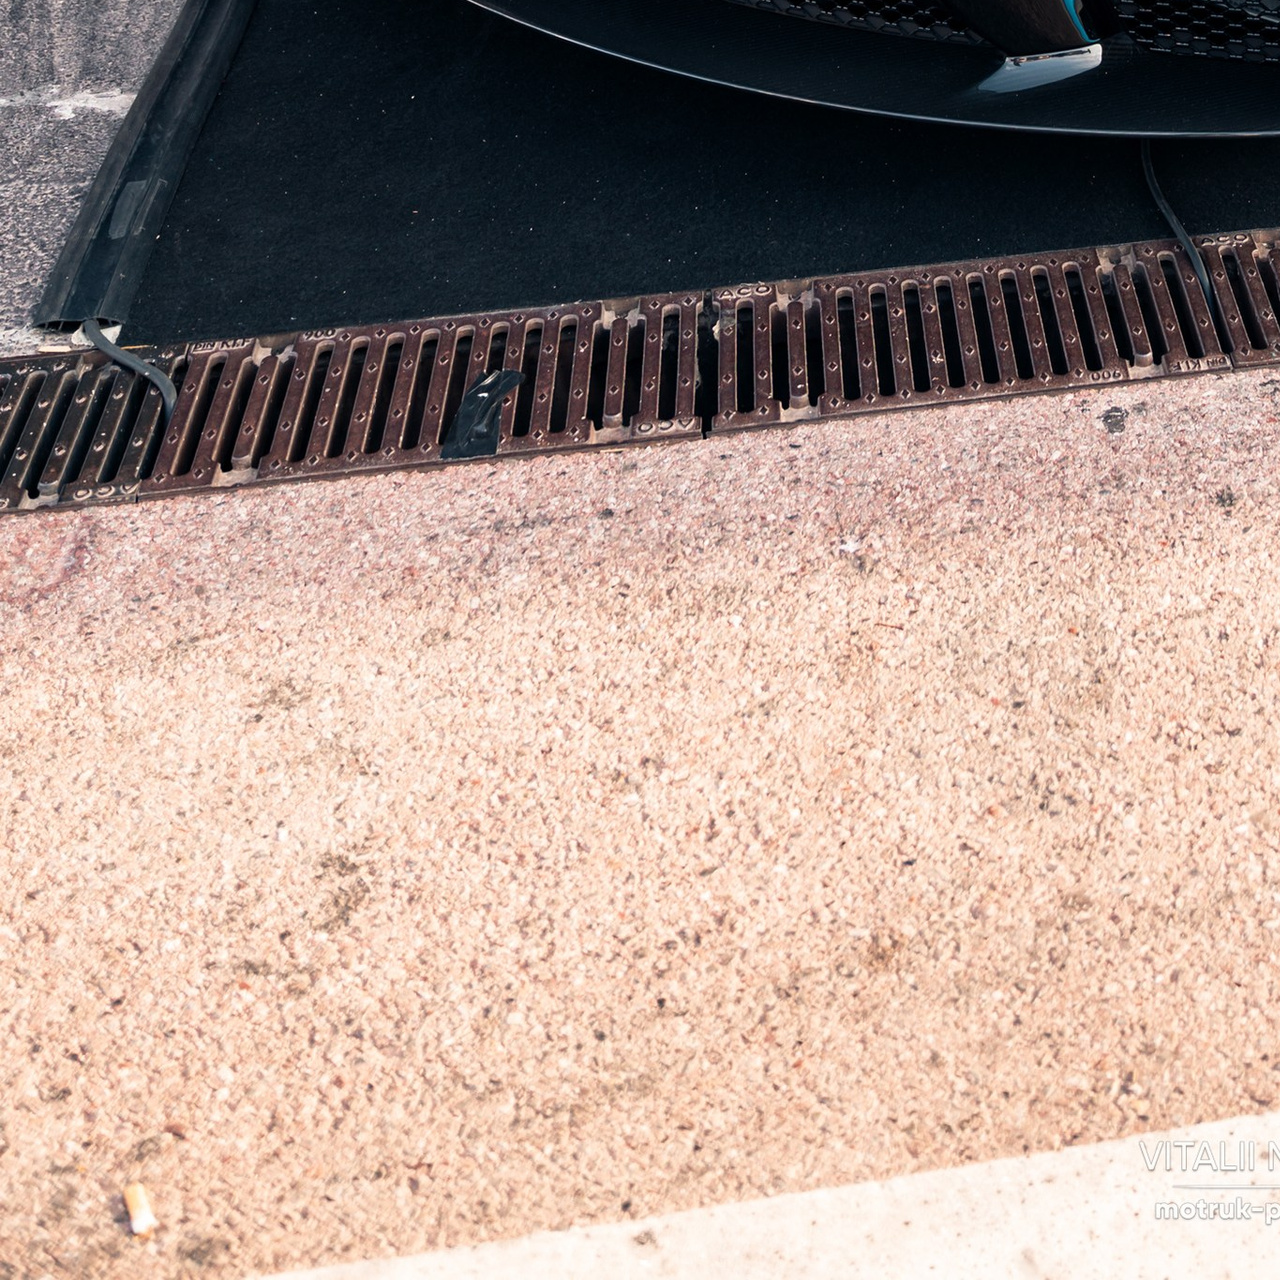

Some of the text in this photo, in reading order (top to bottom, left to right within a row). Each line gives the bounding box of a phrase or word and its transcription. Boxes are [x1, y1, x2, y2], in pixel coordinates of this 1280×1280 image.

[1201, 234, 1249, 246] ACO
[718, 285, 772, 299] ACO
[303, 328, 336, 341] 900
